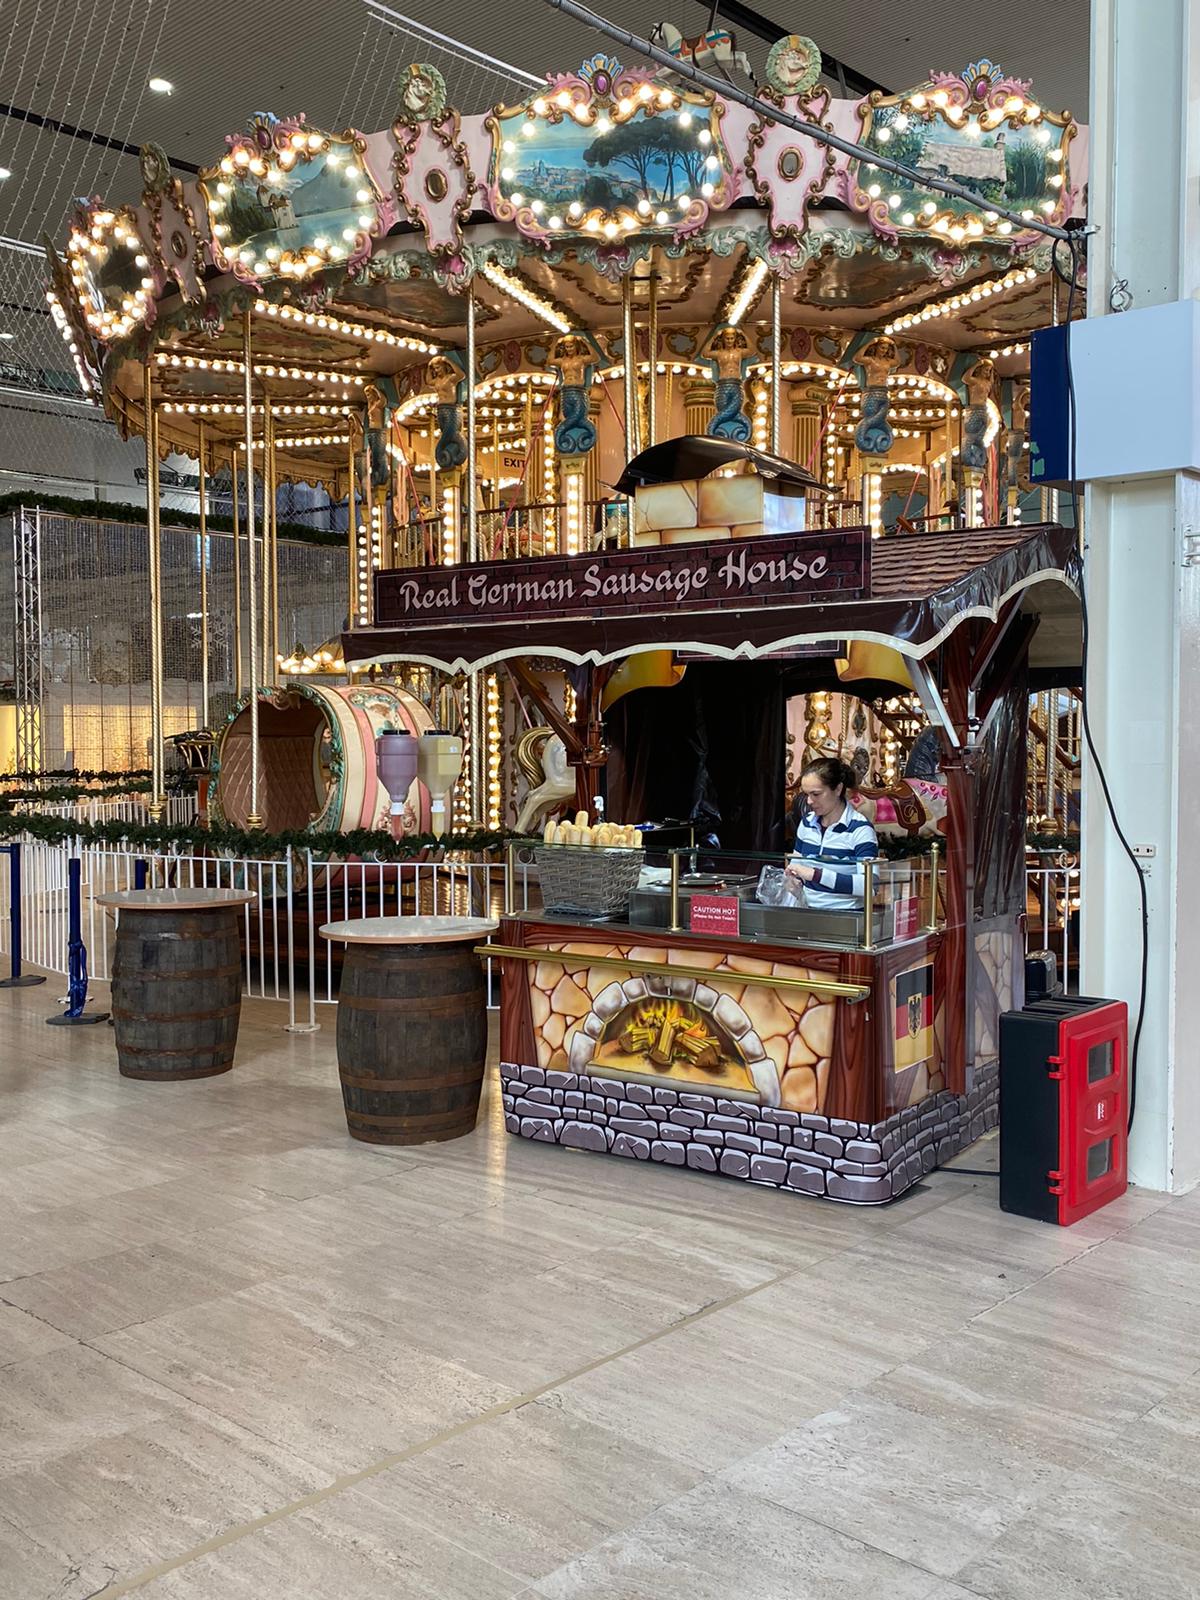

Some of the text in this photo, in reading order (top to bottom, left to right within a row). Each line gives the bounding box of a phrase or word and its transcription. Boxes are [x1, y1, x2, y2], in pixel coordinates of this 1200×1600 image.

[504, 457, 526, 468] EXIT
[400, 548, 829, 613] Real German Sausage House
[693, 906, 721, 914] CAUTION
